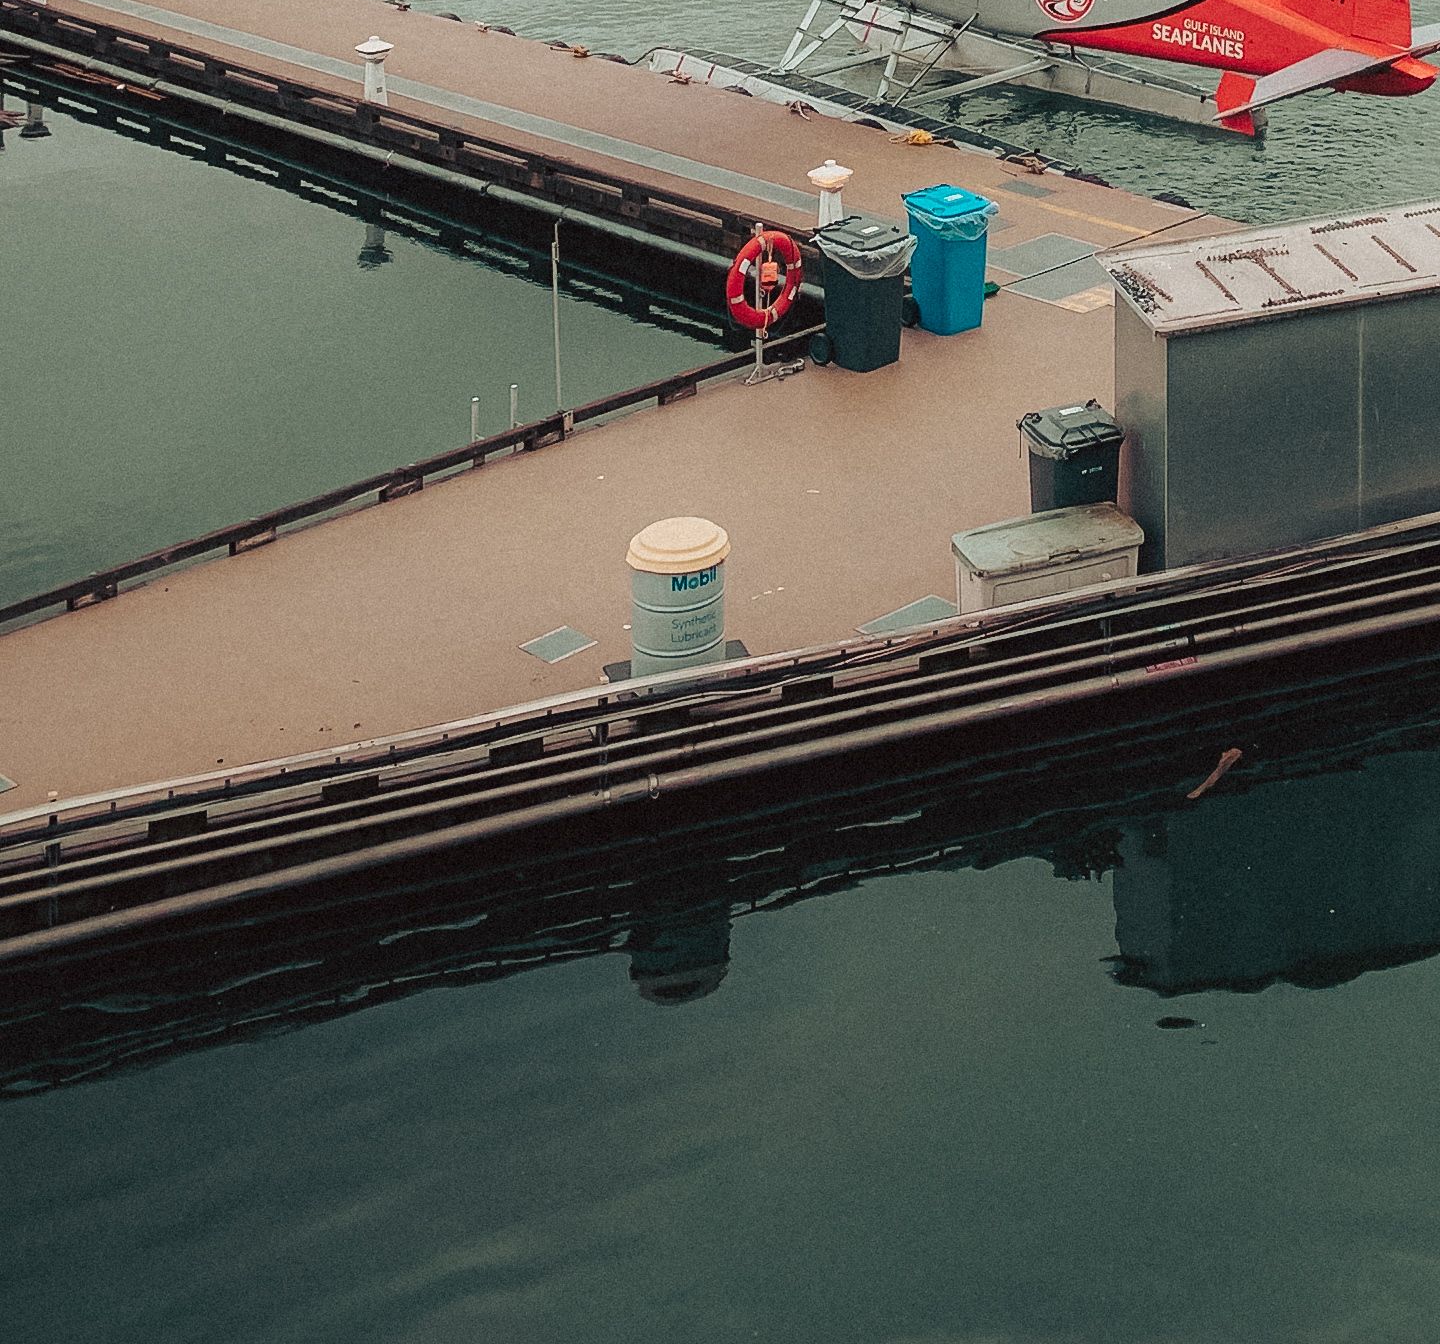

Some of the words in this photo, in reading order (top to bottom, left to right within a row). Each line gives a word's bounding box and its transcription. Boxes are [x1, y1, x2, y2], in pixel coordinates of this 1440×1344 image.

[1152, 23, 1244, 59] SEAPLANES
[1184, 18, 1209, 33] GULF
[1210, 23, 1244, 41] ISLAND
[671, 566, 717, 591] Mobil
